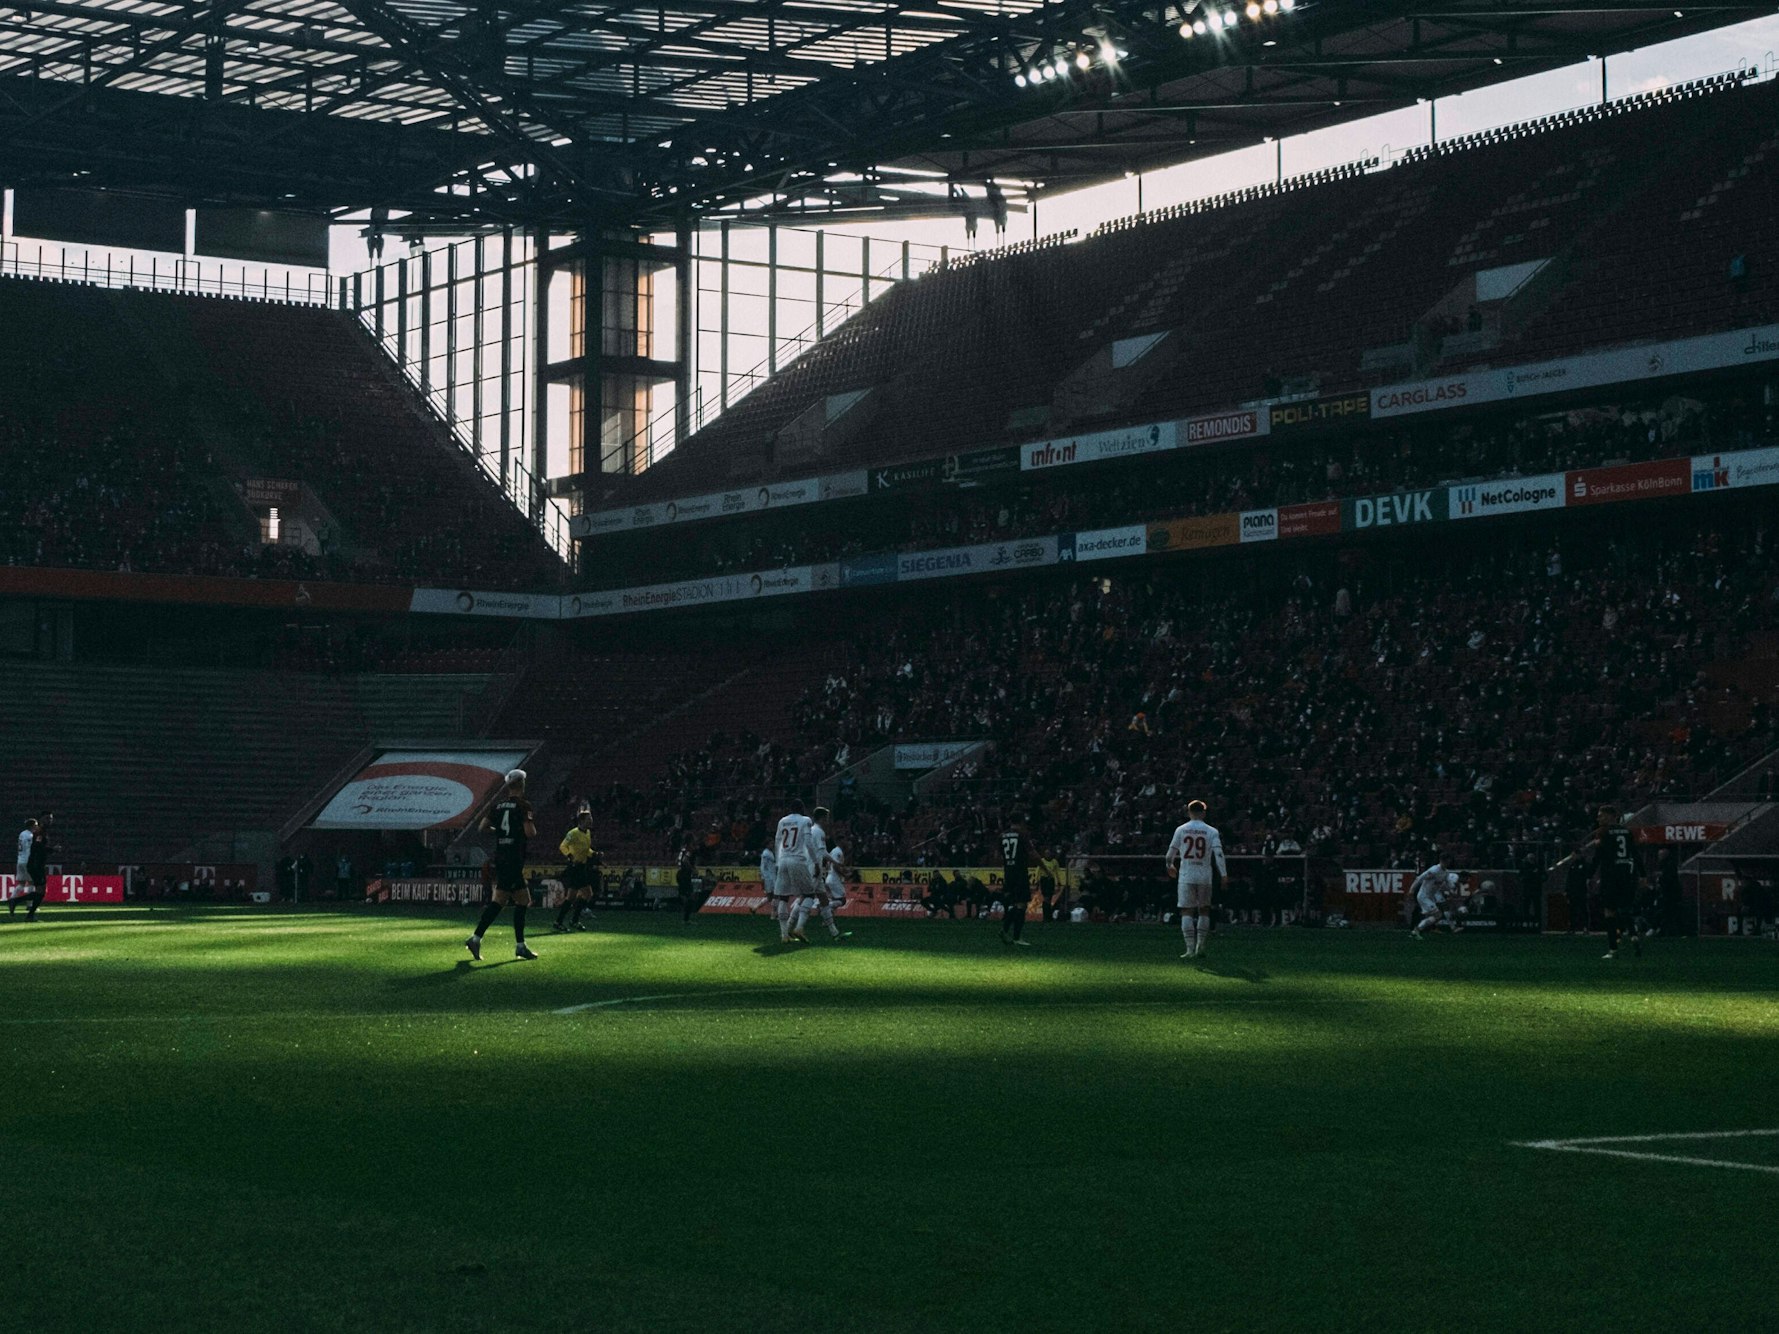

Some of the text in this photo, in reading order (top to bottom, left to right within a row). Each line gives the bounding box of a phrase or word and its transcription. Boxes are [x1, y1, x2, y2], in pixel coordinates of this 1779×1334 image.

[1377, 383, 1467, 410] CARGLASS
[1188, 416, 1252, 440] REMONDIS
[1481, 487, 1557, 507] NetCologne
[1355, 491, 1434, 528] DEVK
[1078, 535, 1142, 553] axa-decker.de
[901, 554, 972, 574] SIEGENIA
[476, 599, 530, 612] RheinEnergie
[376, 805, 451, 816] RheinEnergie
[500, 810, 511, 837] 4
[1665, 825, 1707, 840] REWE
[782, 827, 799, 849] 27
[1002, 838, 1018, 860] 27
[1183, 836, 1207, 860] 29
[1616, 835, 1627, 858] 3
[62, 875, 84, 902] T
[391, 883, 411, 901] BEIM
[412, 883, 432, 901] KAUF
[433, 883, 457, 902] EINES
[1344, 873, 1405, 894] REWE
